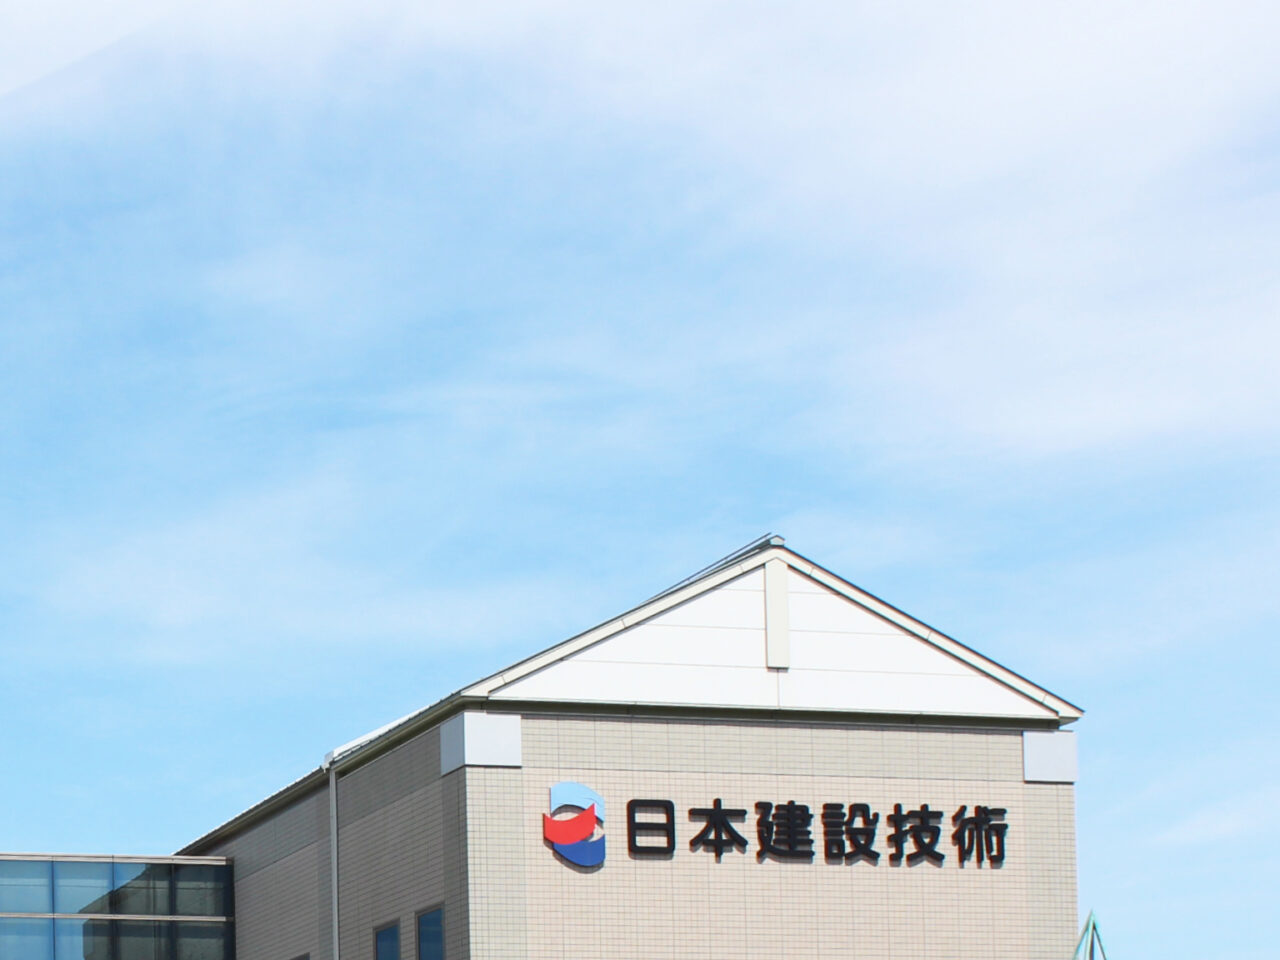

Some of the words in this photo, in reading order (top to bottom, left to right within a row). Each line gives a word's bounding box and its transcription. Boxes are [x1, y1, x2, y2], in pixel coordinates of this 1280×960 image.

[626, 797, 1008, 868] 日本建設技術
